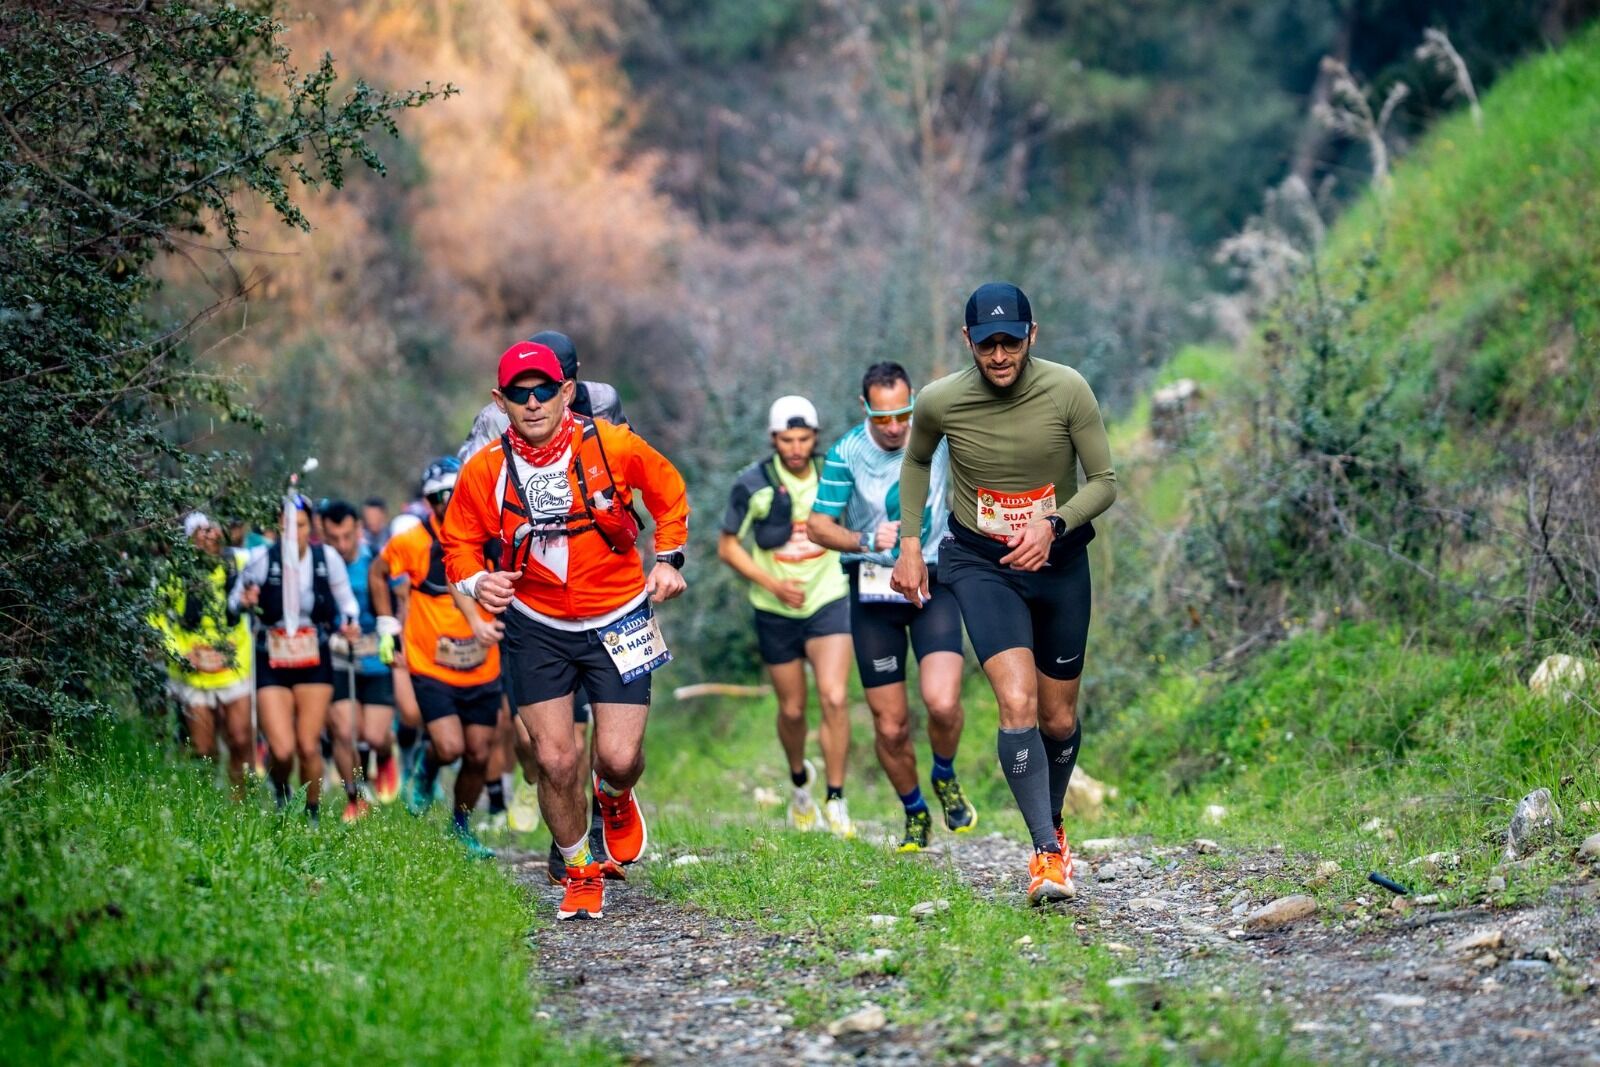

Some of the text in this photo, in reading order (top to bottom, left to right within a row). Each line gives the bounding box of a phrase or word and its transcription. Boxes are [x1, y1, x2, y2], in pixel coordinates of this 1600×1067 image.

[1003, 511, 1033, 521] SUAT
[627, 631, 655, 651] HASAN
[643, 646, 653, 656] 49
